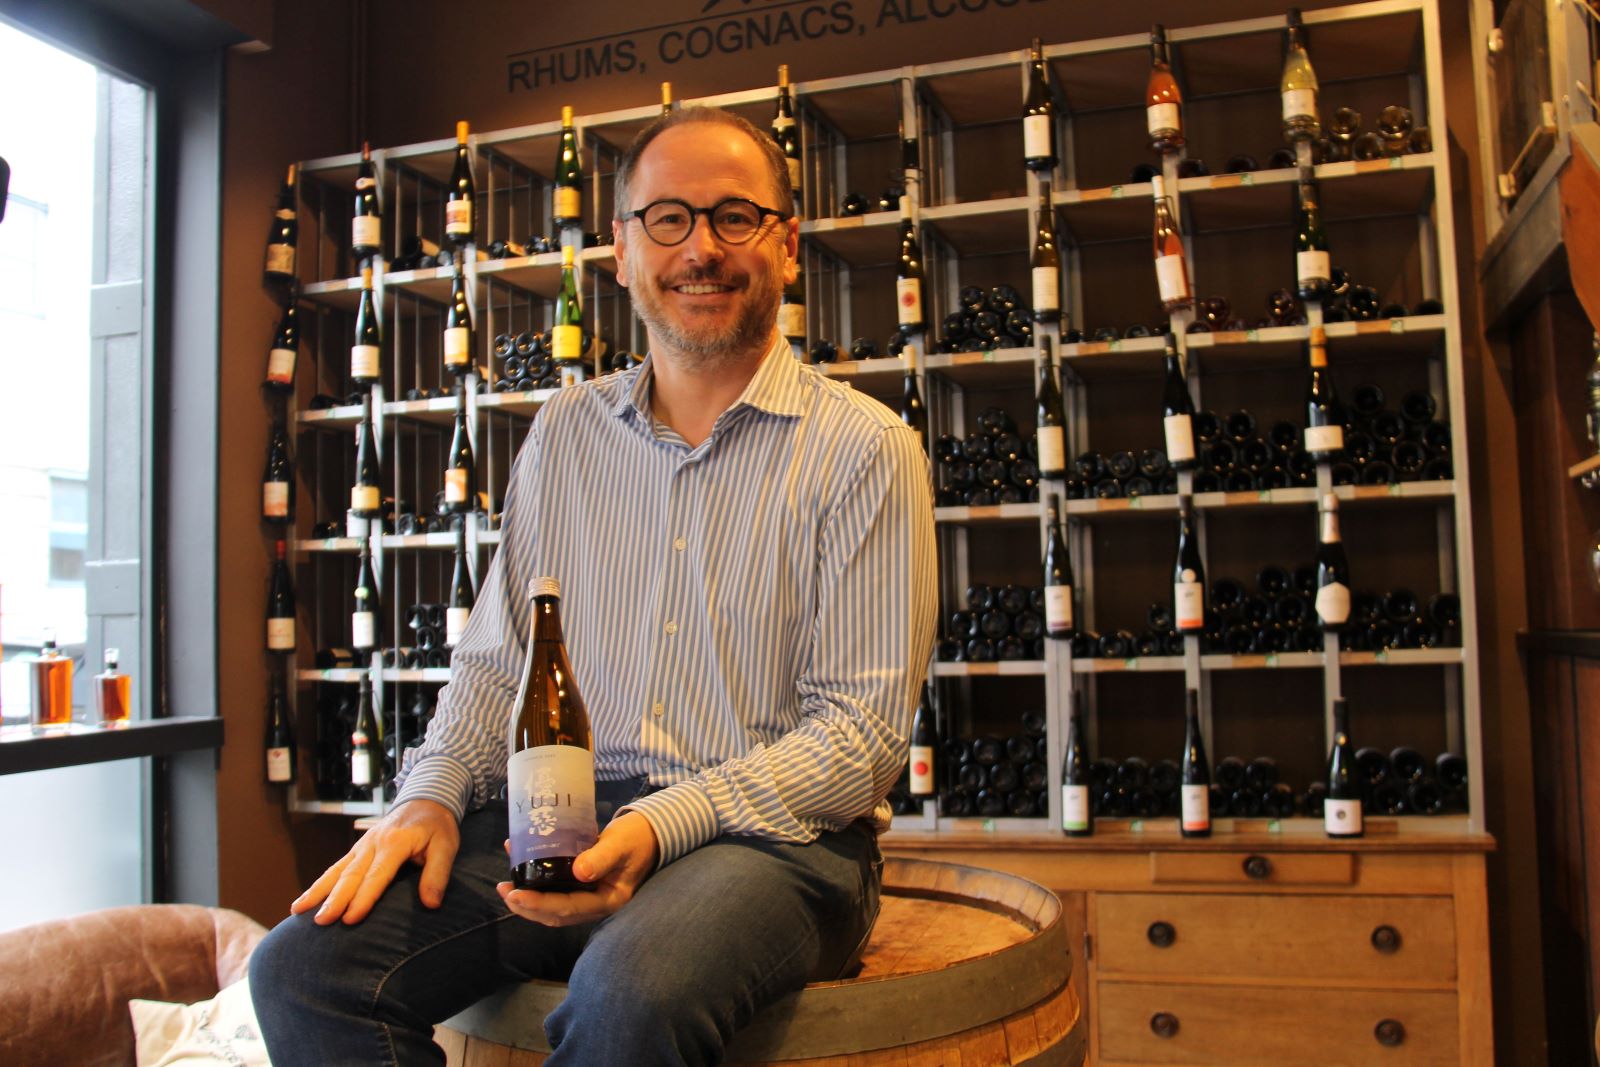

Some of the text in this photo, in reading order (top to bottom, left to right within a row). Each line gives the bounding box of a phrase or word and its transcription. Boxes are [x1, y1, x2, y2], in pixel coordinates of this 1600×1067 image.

[508, 0, 1049, 93] RHUMS, COGNACS, ALC
[515, 793, 571, 814] YUJI
